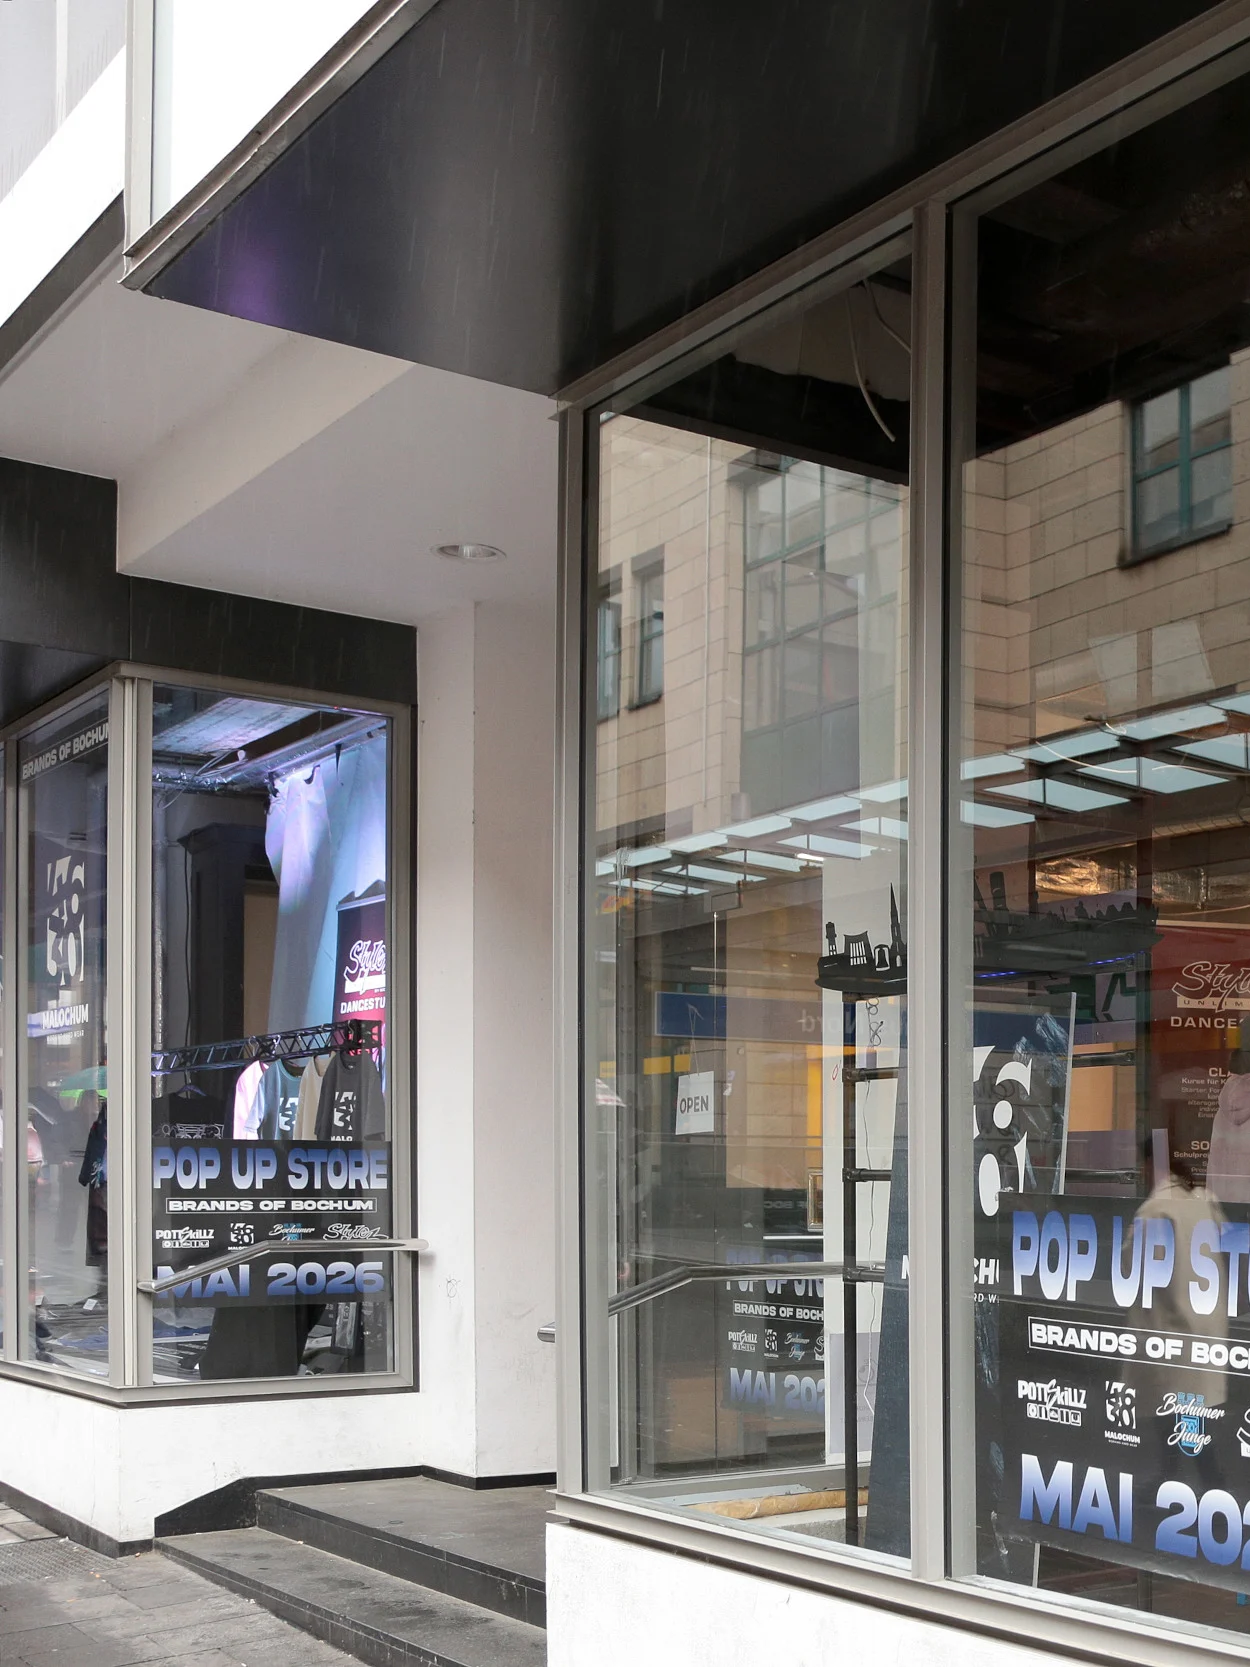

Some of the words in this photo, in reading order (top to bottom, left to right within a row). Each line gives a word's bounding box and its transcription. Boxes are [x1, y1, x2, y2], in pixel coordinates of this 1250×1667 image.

[22, 748, 58, 780] BRANDS
[59, 741, 72, 761] OF
[42, 1003, 89, 1030] MALOCHUM
[679, 1095, 709, 1114] OPEN
[153, 1147, 221, 1189] POP
[231, 1147, 278, 1189] UP
[288, 1147, 388, 1190] STORE
[168, 1200, 254, 1212] BRANDS
[259, 1200, 286, 1212] OF
[291, 1200, 374, 1212] BOCHUM
[1012, 1211, 1098, 1302] POP
[1111, 1216, 1175, 1309] UP
[156, 1264, 250, 1299] MAI
[267, 1261, 385, 1297] 2026
[734, 1302, 777, 1317] BRANDS
[778, 1305, 795, 1319] OF
[1031, 1323, 1138, 1356] BRANDS
[1145, 1336, 1184, 1360] OF
[729, 1367, 776, 1405] MAI
[1156, 1392, 1226, 1421] Bochumer
[1104, 1430, 1141, 1444] MALOCHUM
[1167, 1421, 1213, 1454] Junge
[1019, 1453, 1134, 1544] MAI
